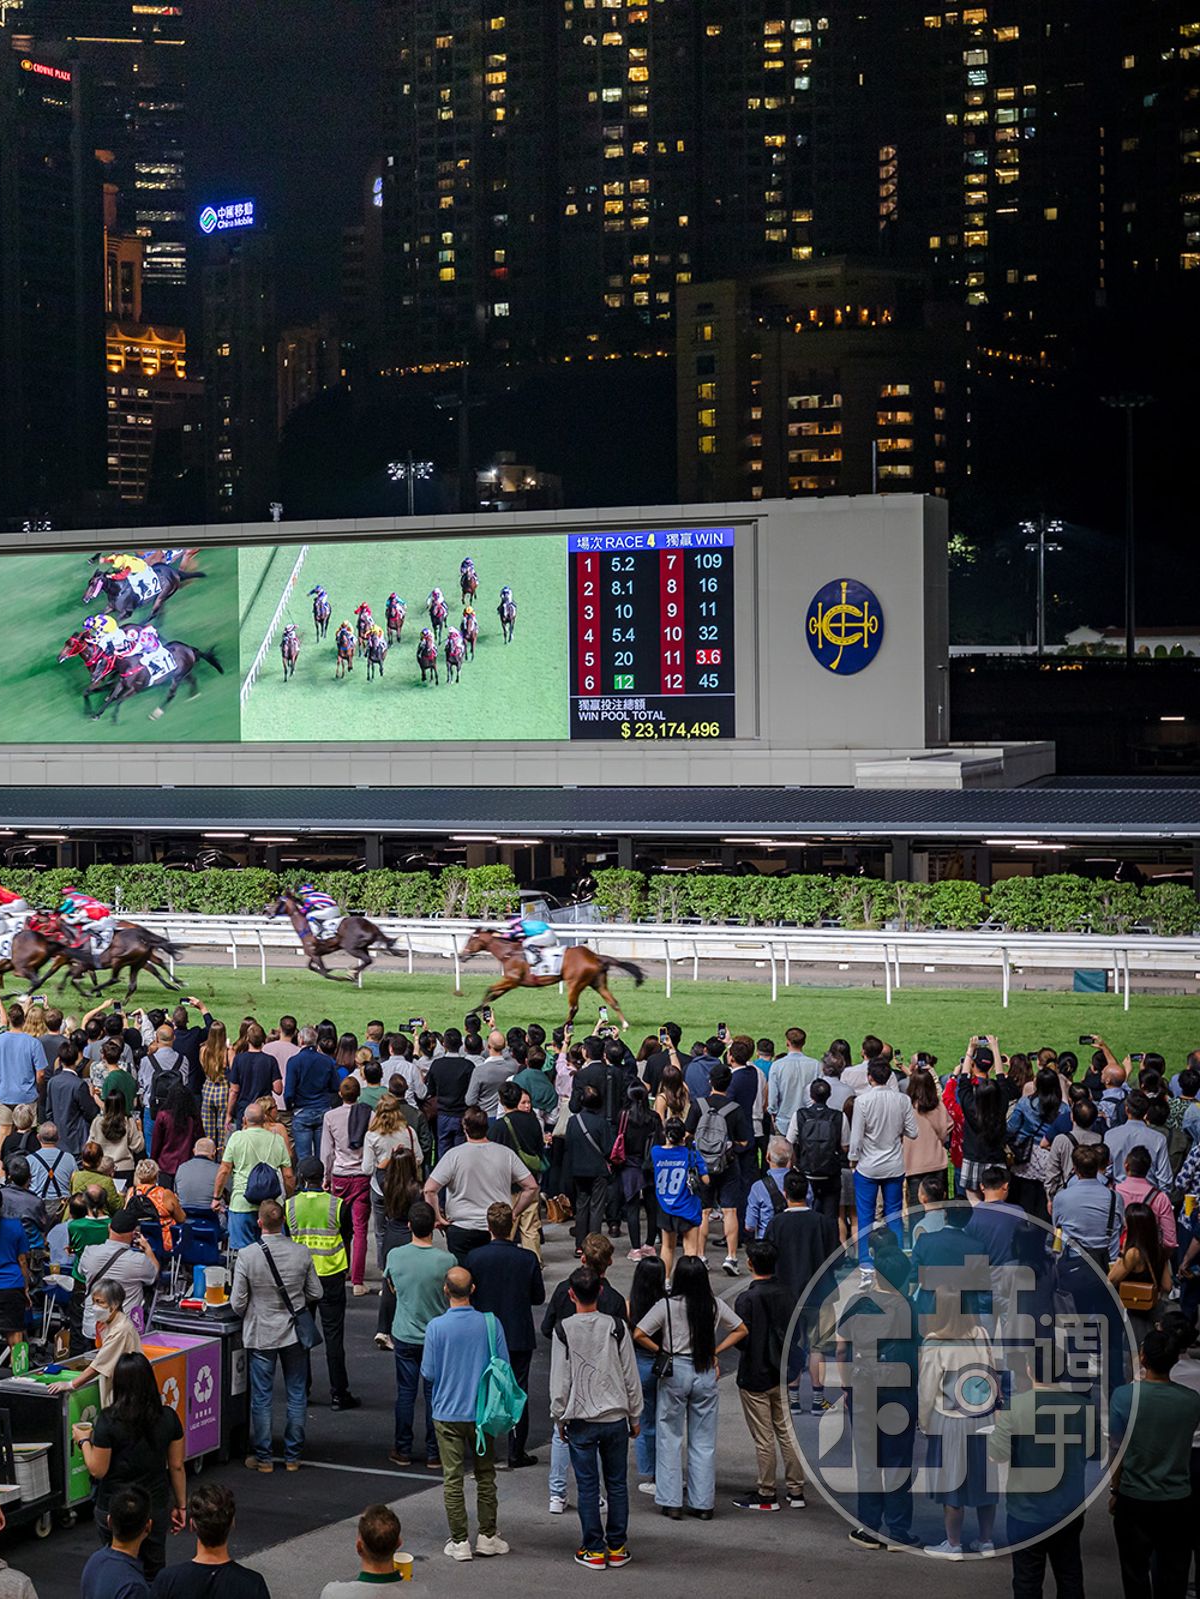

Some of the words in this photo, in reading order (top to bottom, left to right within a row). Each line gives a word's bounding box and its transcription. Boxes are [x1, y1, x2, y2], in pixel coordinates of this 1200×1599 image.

[33, 63, 54, 77] CROWNE
[54, 68, 71, 81] PLAZA
[217, 219, 234, 229] China
[234, 215, 253, 226] Mobile
[577, 537, 604, 550] 場次
[606, 537, 643, 548] RACE
[647, 534, 655, 547] 4
[666, 534, 693, 547] 獨贏
[695, 533, 723, 545] WIN
[585, 559, 592, 572] 1
[611, 557, 635, 571] 5.2
[667, 556, 677, 569] 7
[694, 554, 722, 569] 109
[152, 577, 162, 593] 2
[584, 582, 594, 596] 2
[611, 581, 633, 595] 8.1
[667, 579, 677, 593] 8
[699, 578, 718, 592] 16
[584, 605, 594, 619] 3
[615, 605, 633, 618] 10
[667, 603, 677, 617] 9
[699, 602, 717, 616] 11
[584, 629, 594, 642] 4
[612, 628, 635, 642] 5.4
[664, 627, 682, 641] 10
[699, 626, 718, 640] 32
[163, 653, 178, 670] 11
[585, 653, 594, 666] 5
[614, 652, 633, 666] 20
[664, 651, 681, 665] 11
[696, 650, 721, 664] 3.6
[585, 676, 595, 690] 6
[615, 675, 634, 689] 12
[664, 674, 682, 688] 12
[699, 673, 719, 687] 45
[578, 711, 599, 721] WIN
[601, 711, 630, 721] POOL
[633, 711, 666, 720] TOTAL
[635, 723, 720, 739] 23,174,496
[656, 1168, 686, 1195] 48
